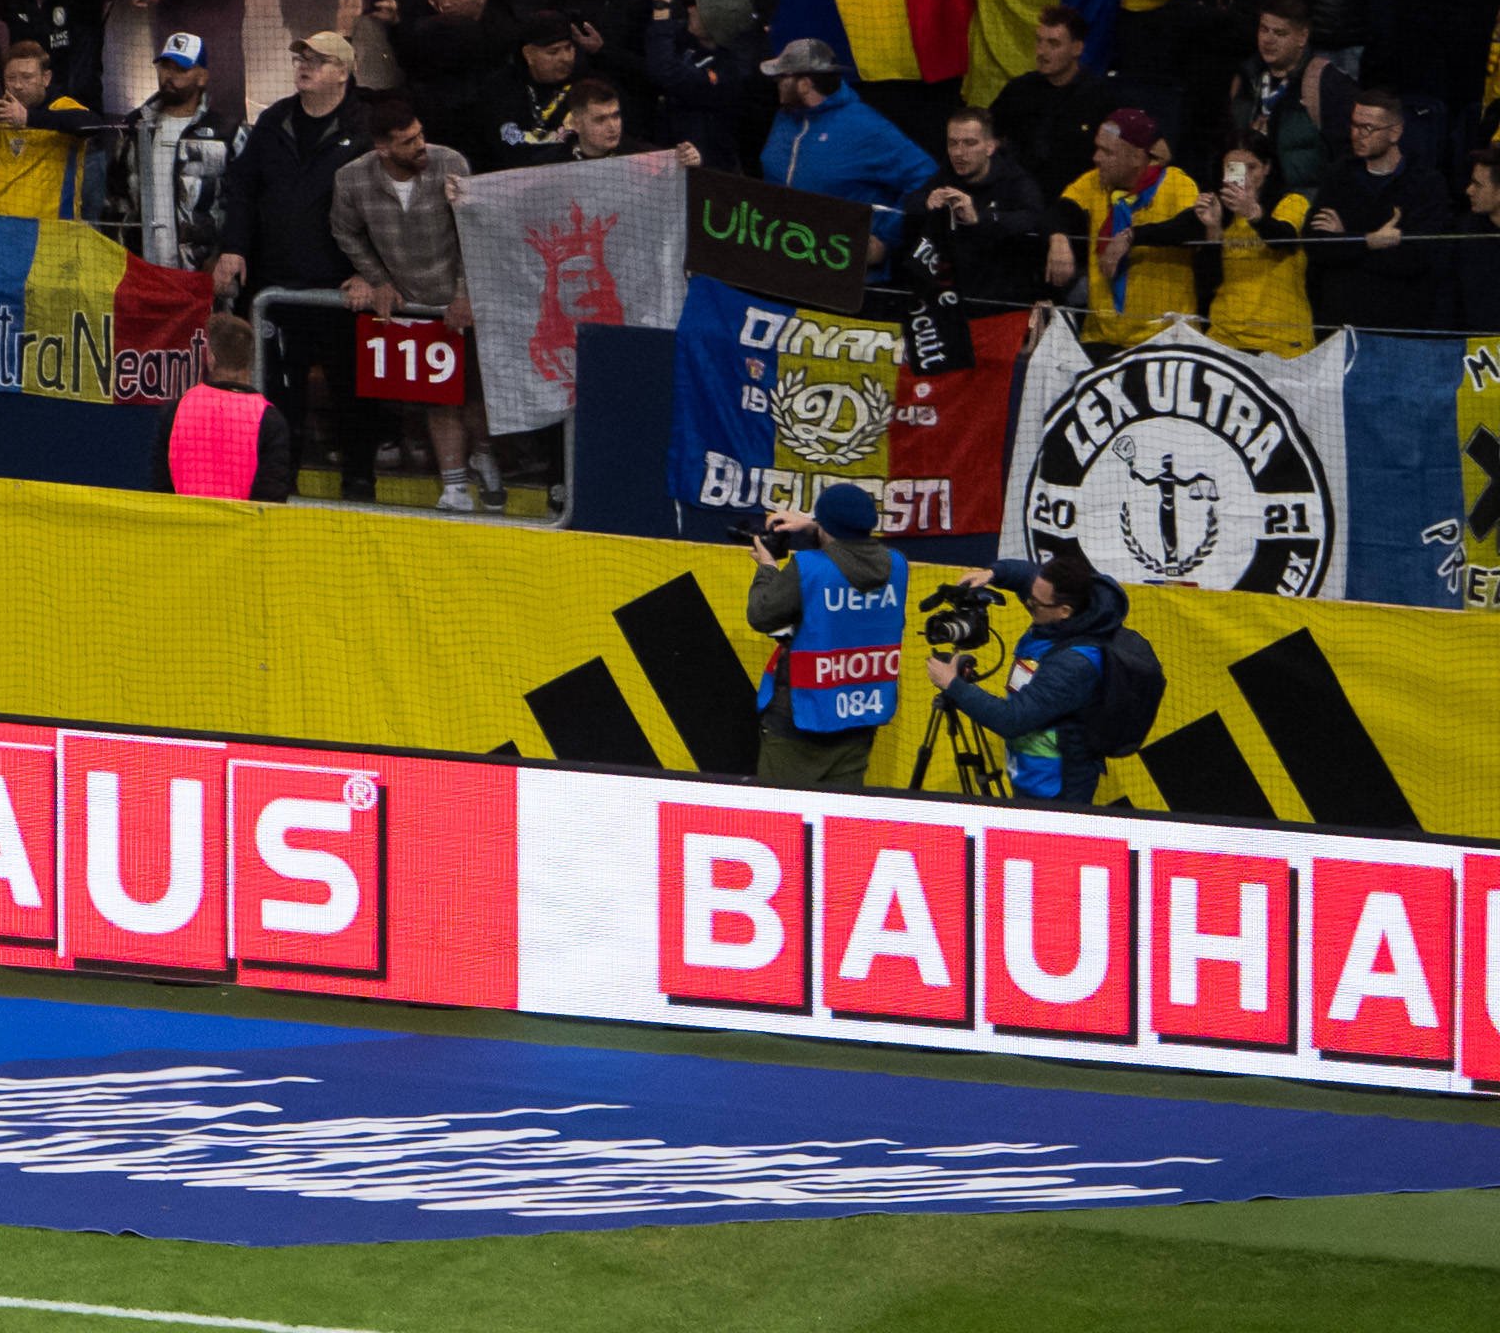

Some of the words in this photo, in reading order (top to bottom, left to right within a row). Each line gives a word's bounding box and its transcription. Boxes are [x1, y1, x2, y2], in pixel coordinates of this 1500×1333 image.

[740, 306, 908, 365] DINAM
[365, 336, 457, 385] 119
[1145, 360, 1285, 477] ULTRA
[1033, 493, 1076, 530] 20
[1264, 502, 1311, 534] 21
[824, 583, 898, 611] UEFA
[816, 649, 900, 683] PHOTO
[836, 689, 884, 719] 084
[683, 832, 1500, 1030] BAUHA
